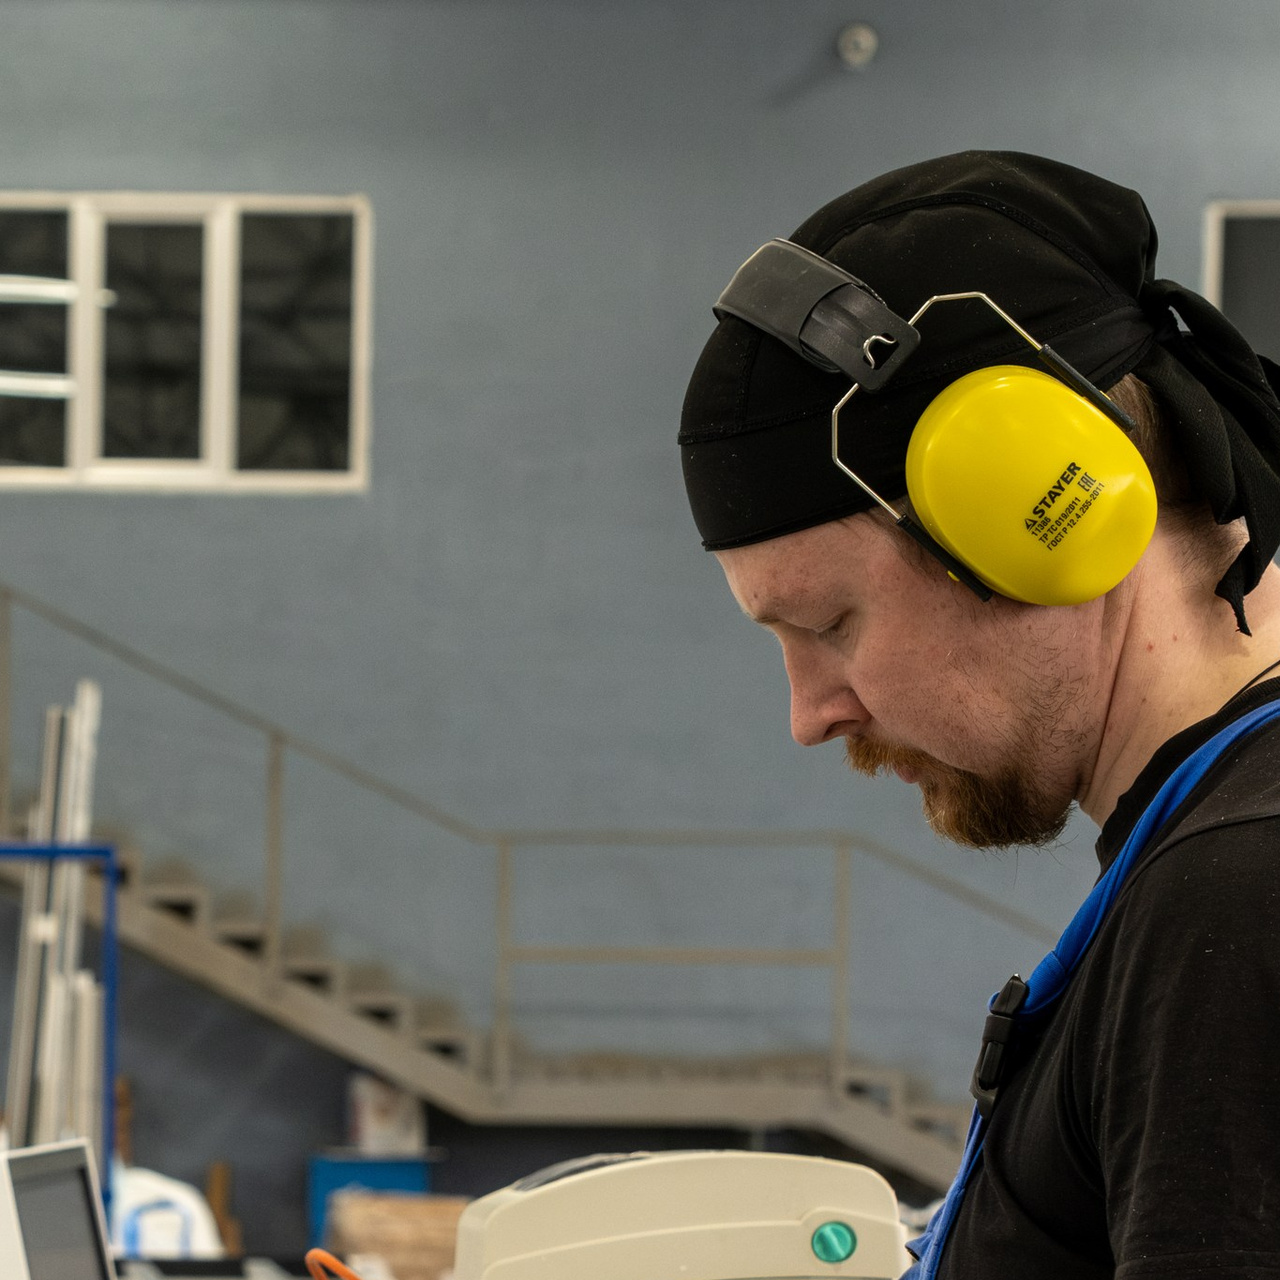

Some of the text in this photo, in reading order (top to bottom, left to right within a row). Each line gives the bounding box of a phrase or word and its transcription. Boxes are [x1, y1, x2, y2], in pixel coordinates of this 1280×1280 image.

[1031, 461, 1082, 519] STAYER
[1054, 496, 1081, 527] 019/2011
[1031, 515, 1052, 538] 11386
[1046, 532, 1065, 551] ГОСТ
[1066, 482, 1105, 529] 12.4.255-2011
